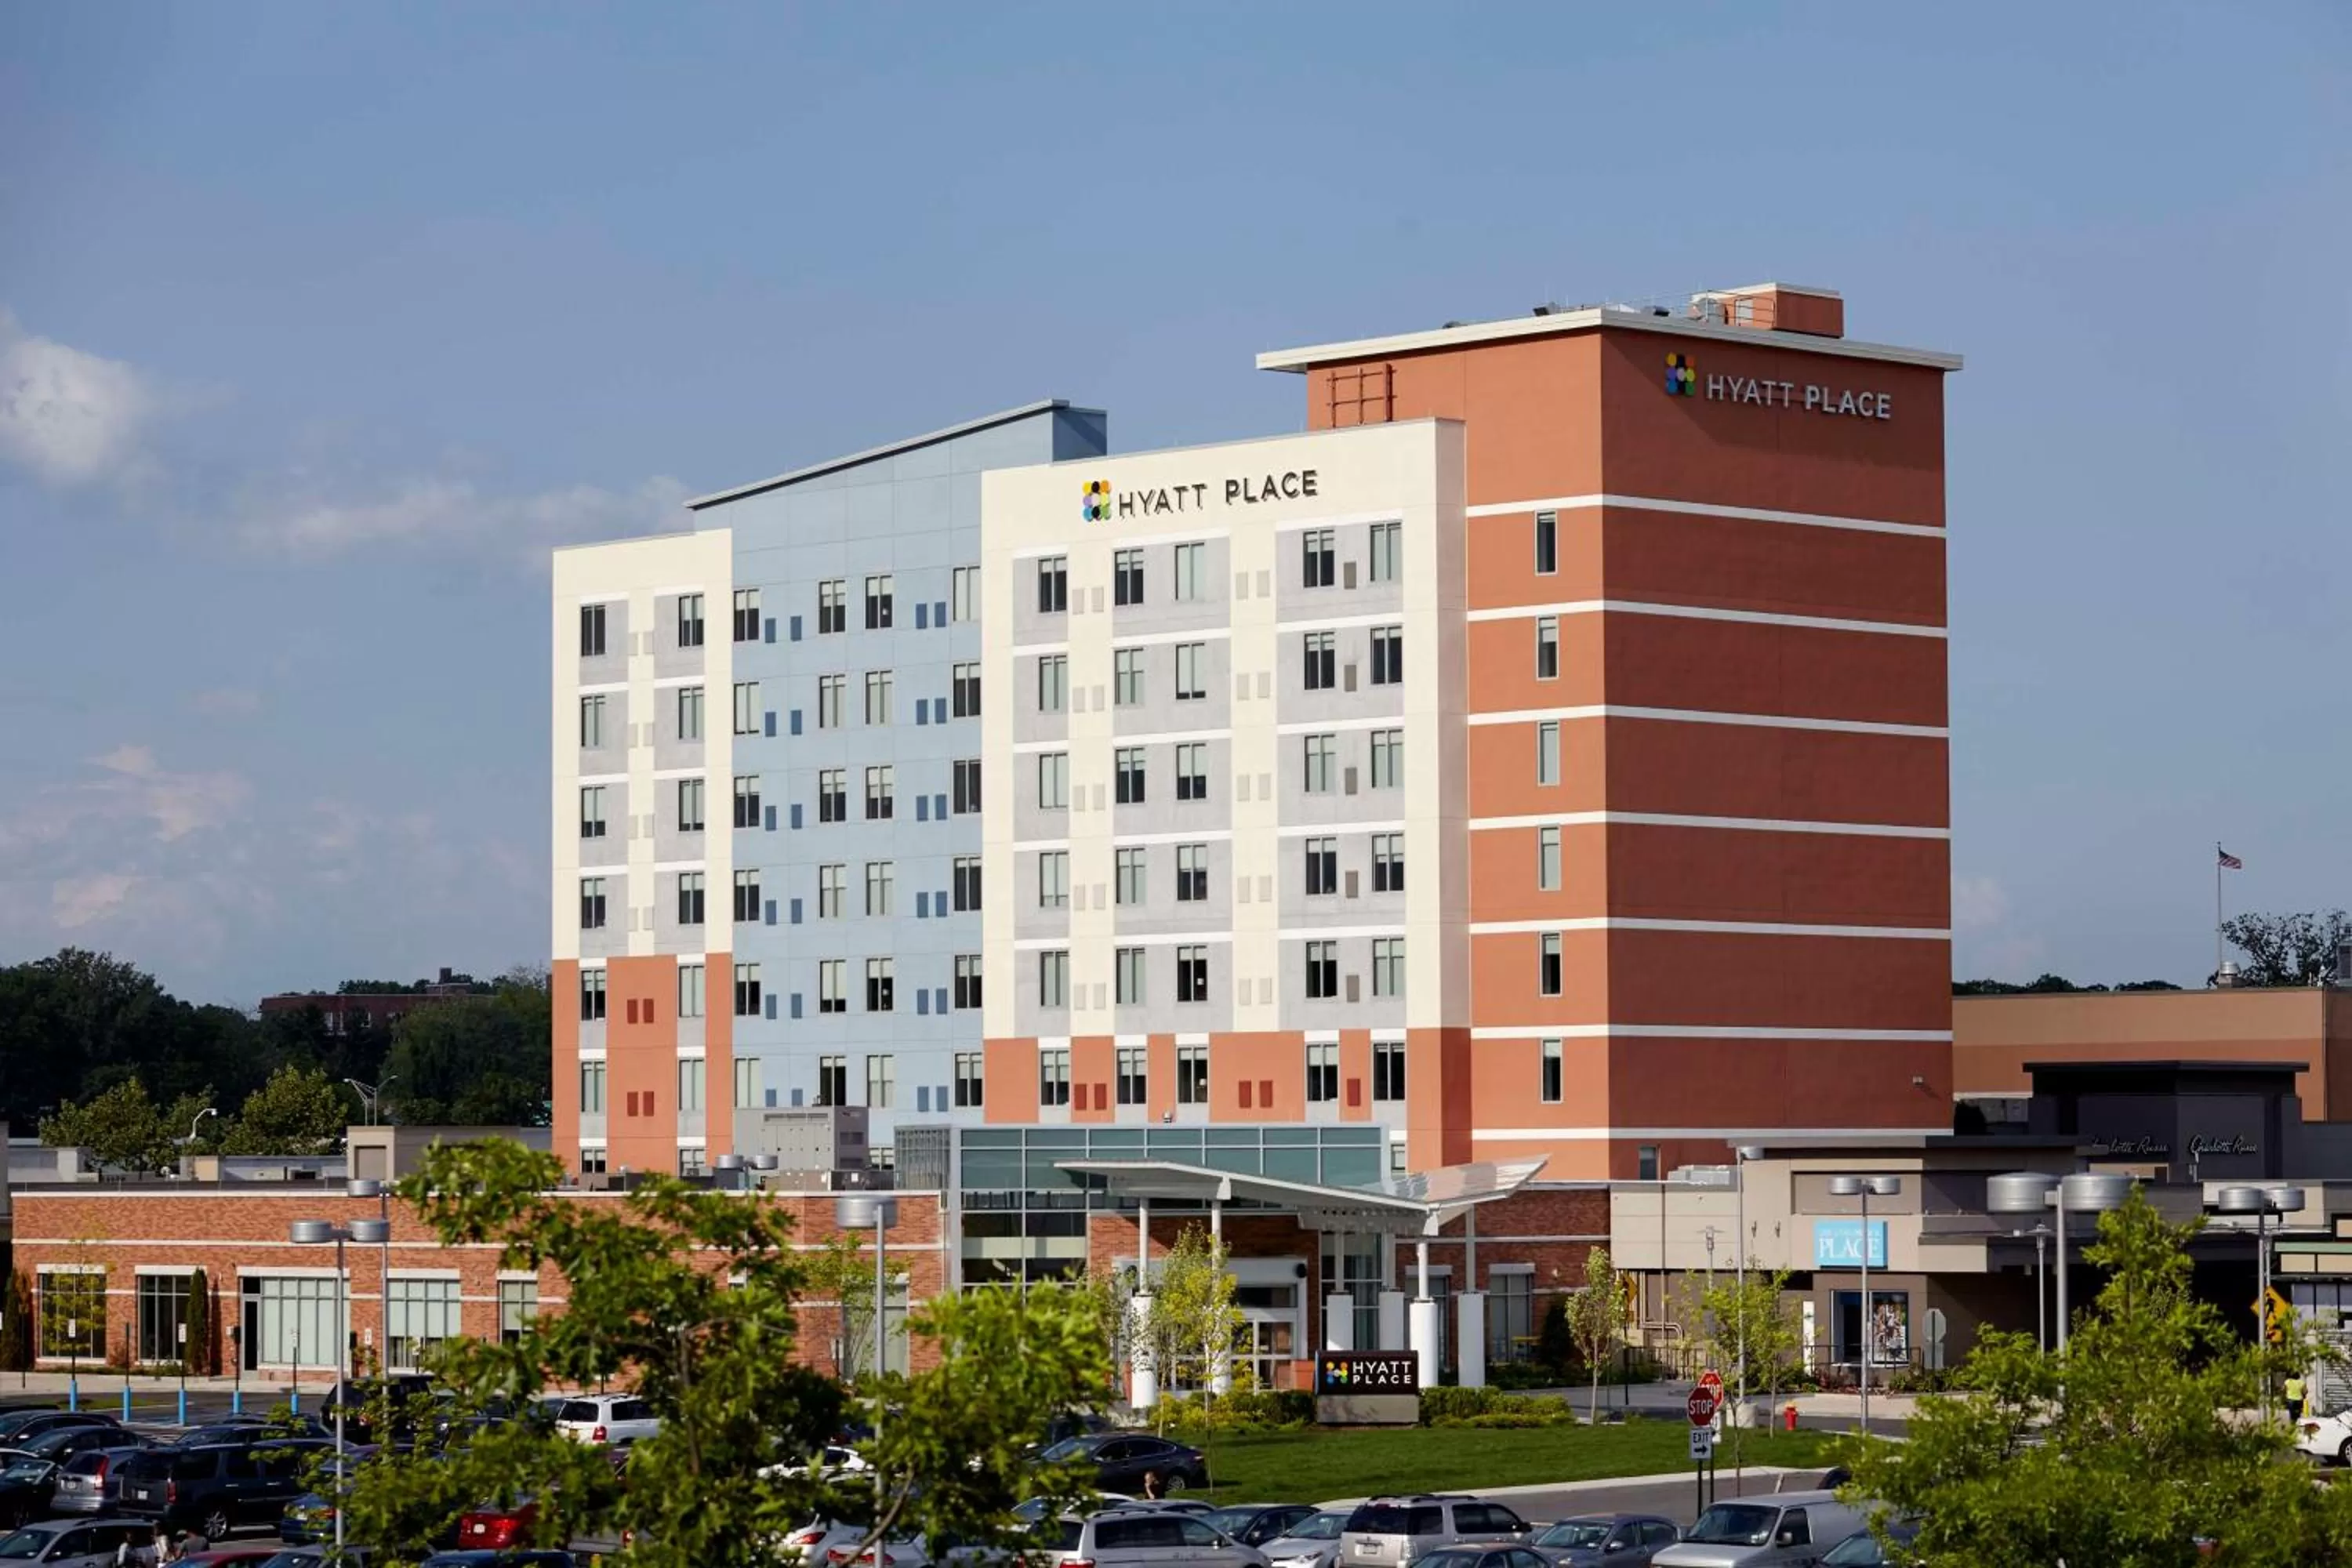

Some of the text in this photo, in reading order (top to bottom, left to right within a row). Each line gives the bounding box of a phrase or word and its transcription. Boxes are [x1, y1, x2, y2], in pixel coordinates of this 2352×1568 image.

[1707, 373, 1891, 419] HYATT PLACE
[1118, 470, 1318, 518] HYATT PLACE
[1819, 1238, 1882, 1258] PLACE
[1352, 1361, 1412, 1374] HYATT
[1352, 1375, 1412, 1384] PLACE
[1690, 1399, 1713, 1414] STOP
[1693, 1432, 1709, 1443] EXIT
